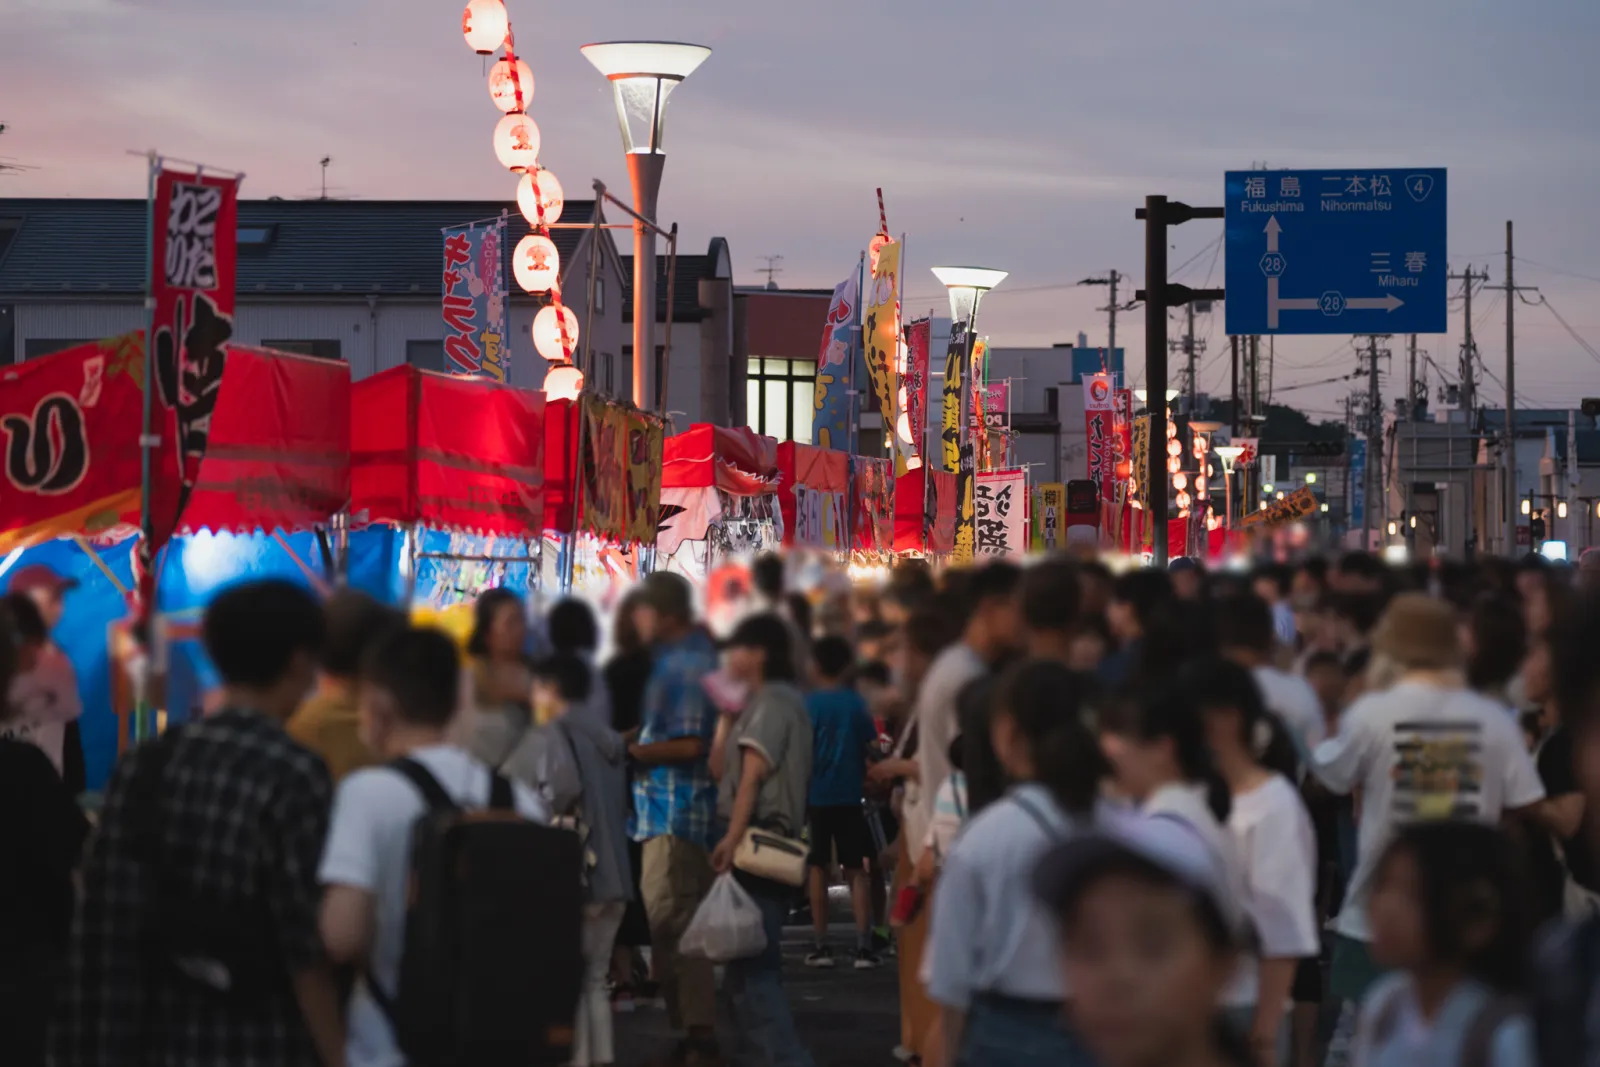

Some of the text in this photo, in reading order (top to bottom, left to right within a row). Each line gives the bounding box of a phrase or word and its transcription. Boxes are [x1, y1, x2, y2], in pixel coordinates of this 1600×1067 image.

[1244, 176, 1301, 198] 福島
[1321, 175, 1392, 197] 二本松
[1413, 180, 1424, 194] 4
[1241, 200, 1305, 213] Fukushima
[1321, 199, 1392, 212] Nihonmatsu
[1265, 256, 1281, 272] 28
[1370, 251, 1427, 273] 三春
[1378, 275, 1419, 287] Miharu
[1324, 296, 1340, 311] 28
